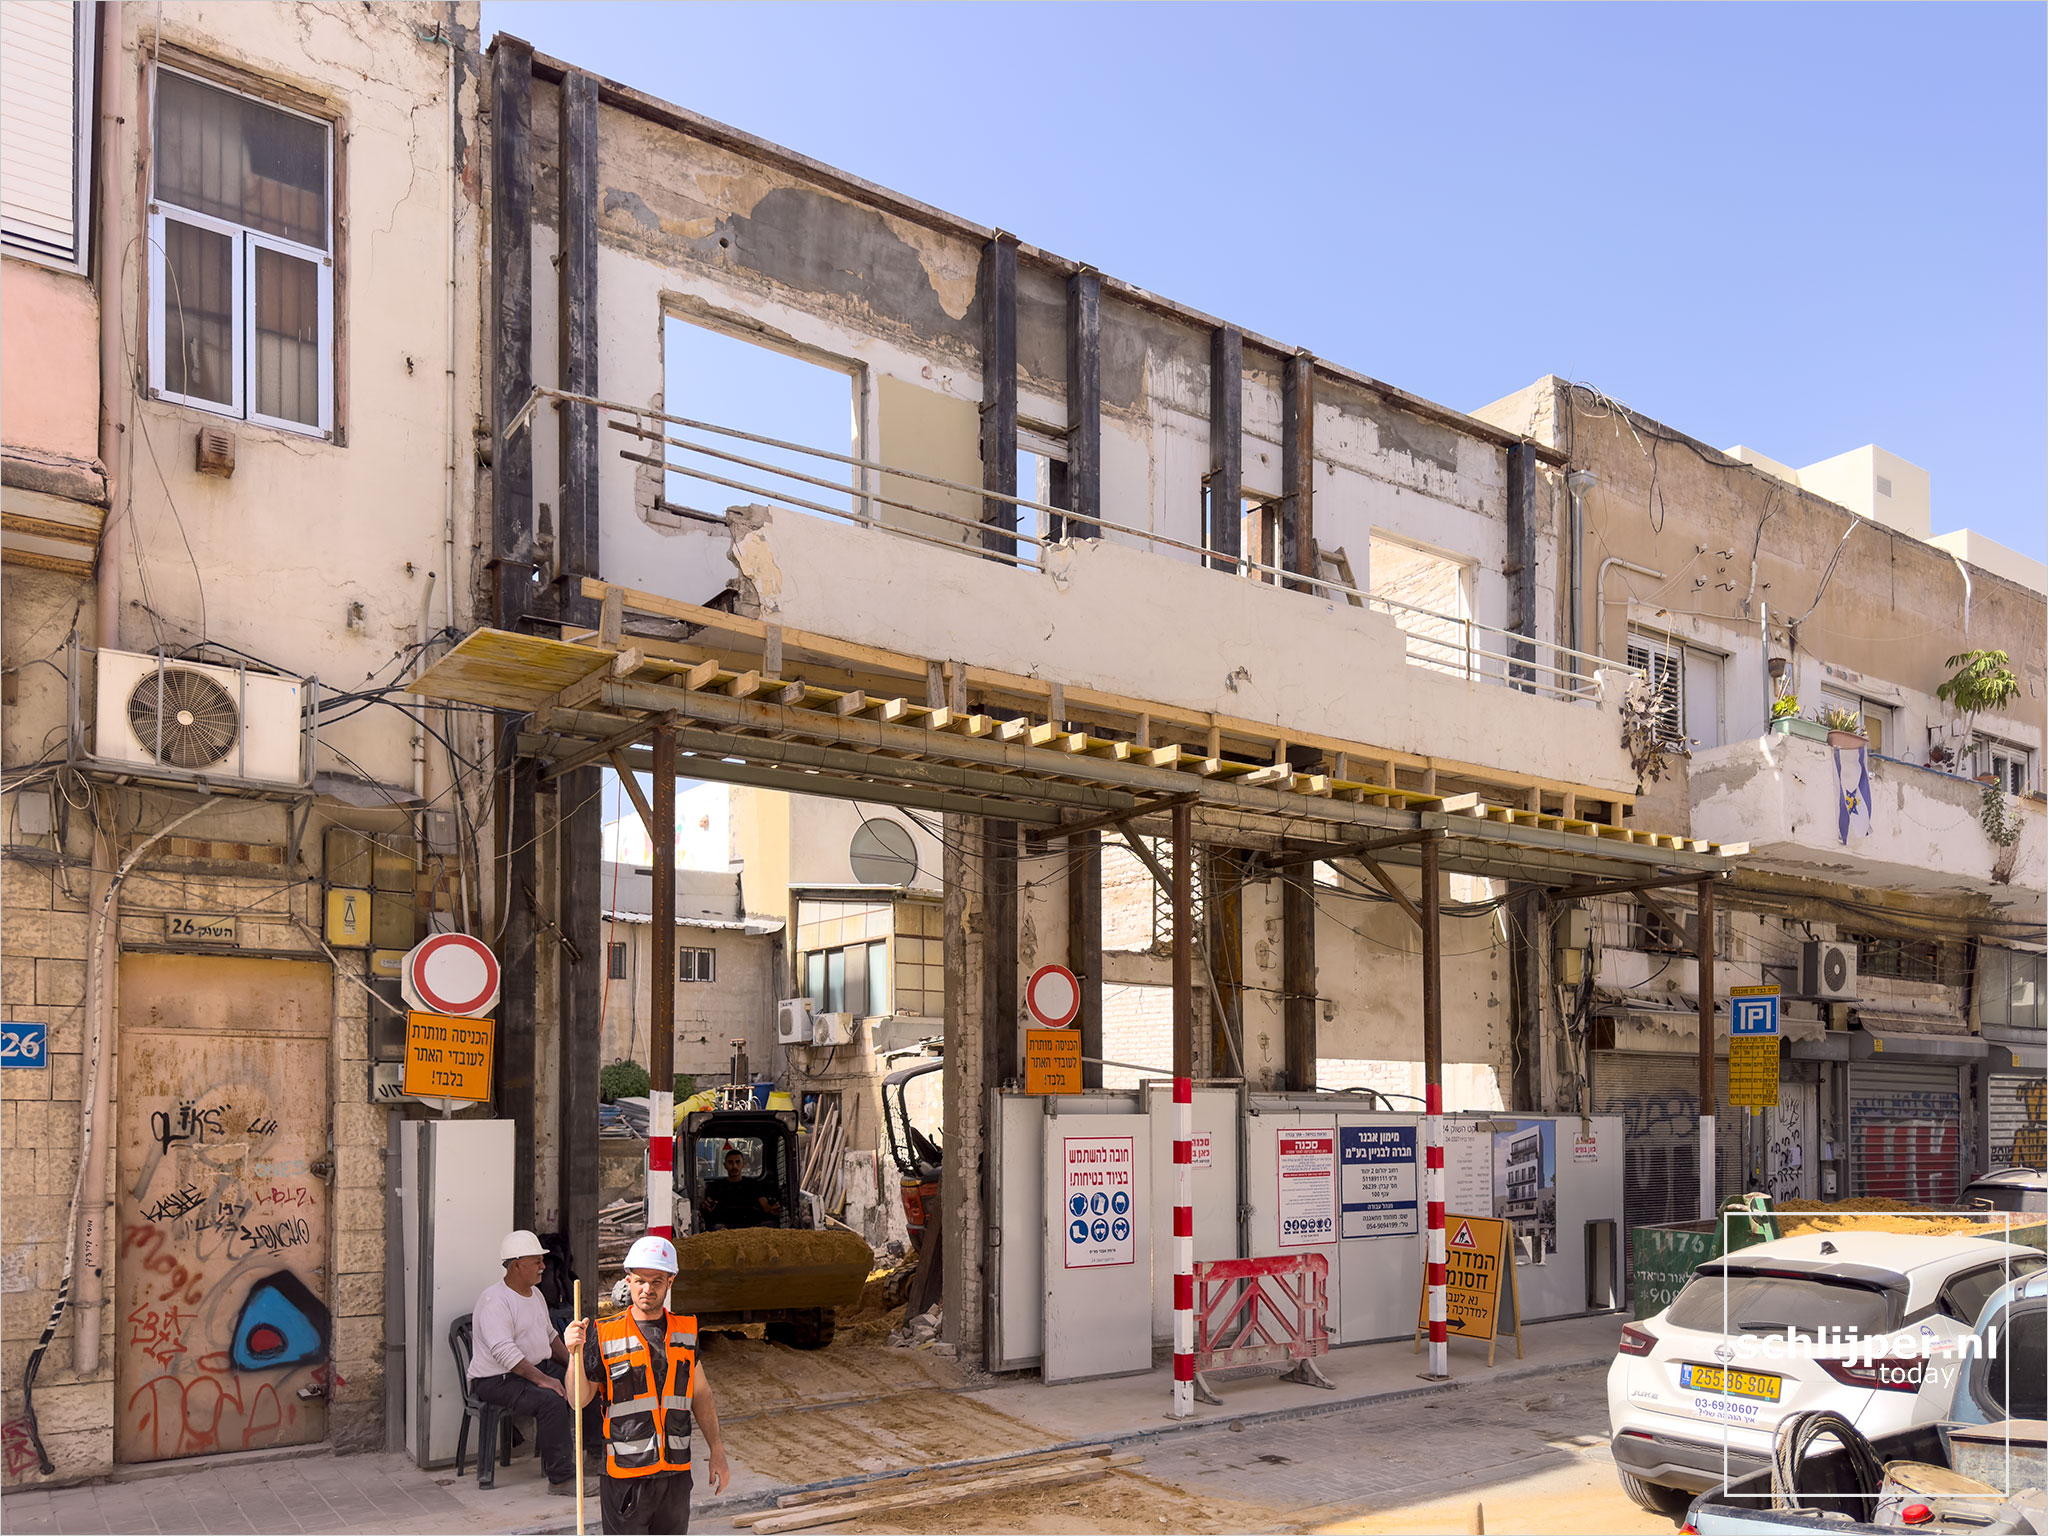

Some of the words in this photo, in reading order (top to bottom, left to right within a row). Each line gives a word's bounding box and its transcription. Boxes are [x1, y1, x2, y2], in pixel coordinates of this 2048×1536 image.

[173, 918, 194, 935] 26
[199, 926, 232, 938] השוק
[411, 1025, 446, 1041] מותרת
[452, 1027, 488, 1045] הכניסה
[1, 1032, 40, 1059] 26
[1029, 1040, 1052, 1051] מותרת
[1055, 1040, 1078, 1051] הכניסה
[414, 1047, 443, 1063] האתר
[449, 1051, 485, 1067] לעובדי
[1031, 1057, 1051, 1068] האתר
[1054, 1056, 1077, 1068] לעובדי
[432, 1071, 463, 1087] בלבד!
[1044, 1074, 1065, 1085] בלבד!
[1358, 1133, 1378, 1142] אבנר
[1380, 1133, 1399, 1145] מימון
[1295, 1141, 1318, 1150] סכנה
[1392, 1147, 1411, 1157] חברה
[1069, 1147, 1107, 1164] להשתמש
[1109, 1149, 1128, 1162] חובה
[1198, 1150, 1210, 1158] כאן
[1346, 1148, 1366, 1158] בע"מ
[1368, 1146, 1390, 1160] לבניין
[1070, 1172, 1103, 1186] בטיחות!
[1106, 1172, 1128, 1185] בציוד
[1652, 1231, 1704, 1253] 1176
[1446, 1269, 1488, 1289] חסומ
[1468, 1296, 1478, 1304] נא
[1452, 1305, 1487, 1318] למדרכה
[1632, 1390, 1658, 1399] JUKE
[1695, 1398, 1759, 1415] 03-6920607
